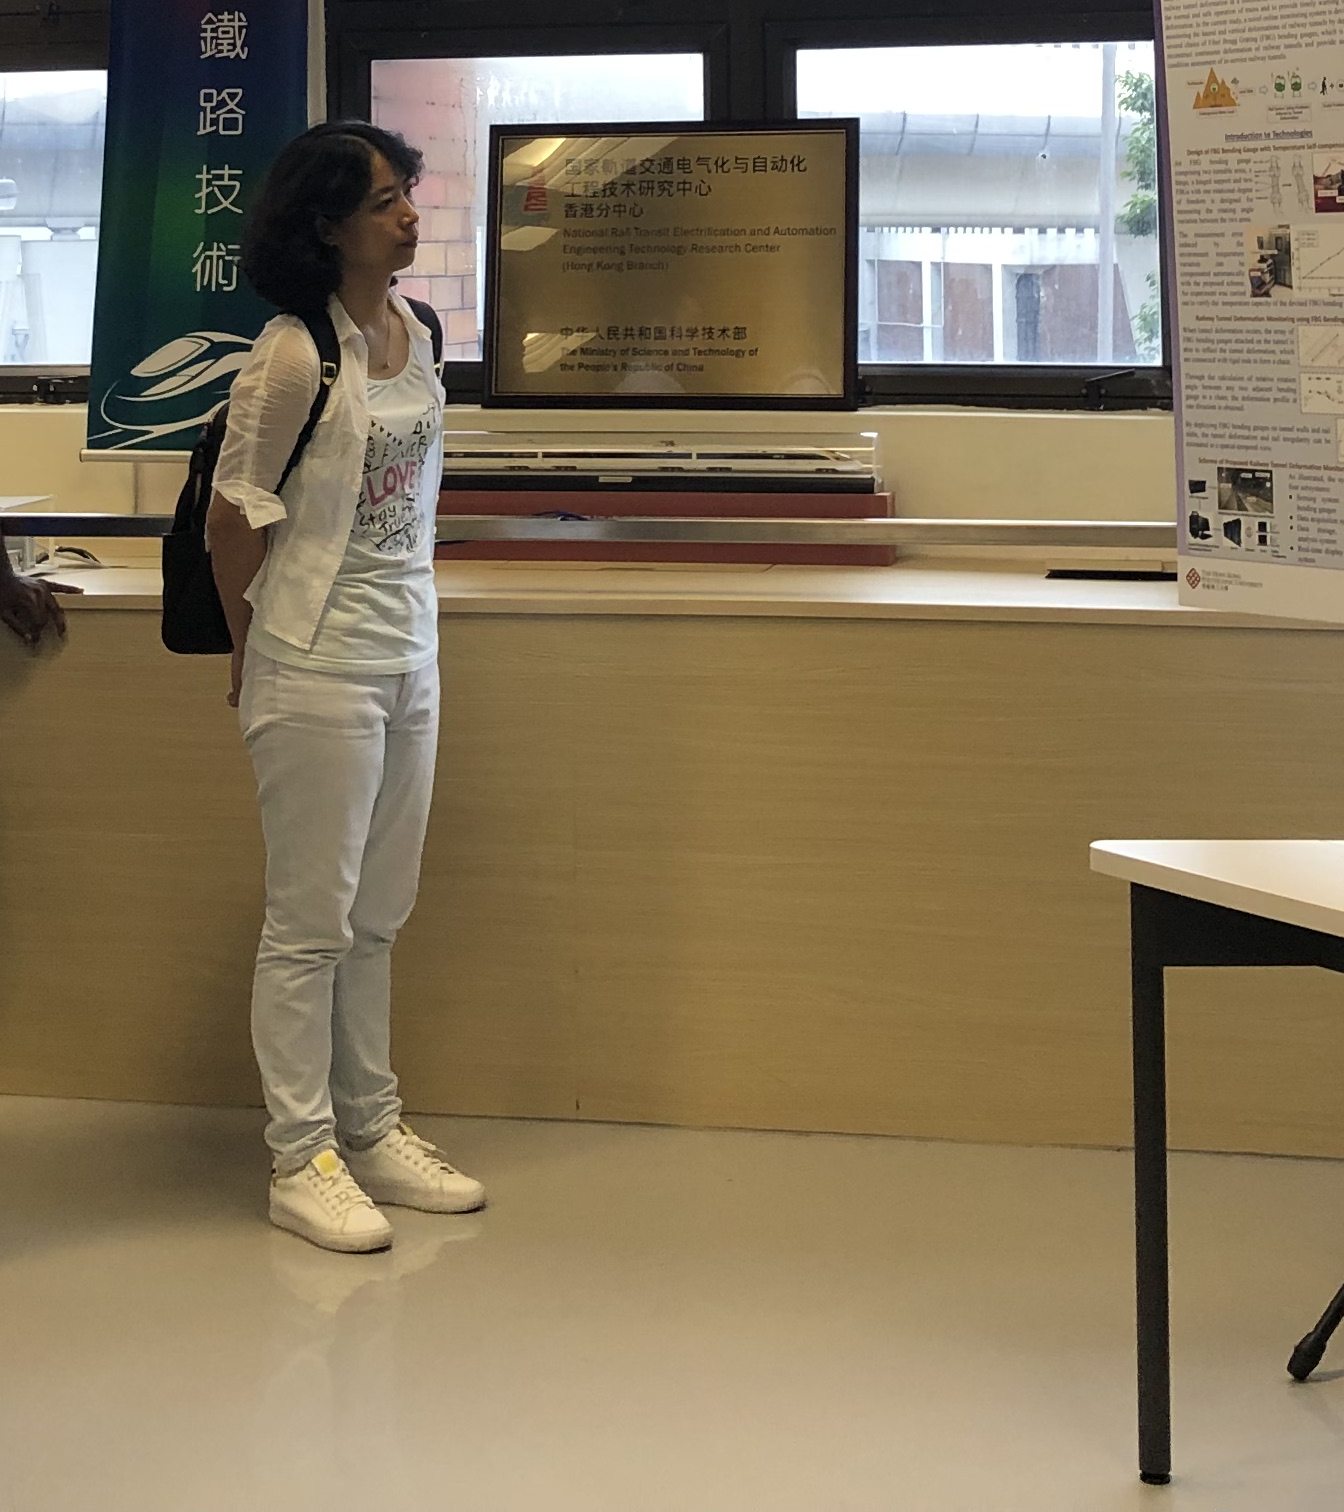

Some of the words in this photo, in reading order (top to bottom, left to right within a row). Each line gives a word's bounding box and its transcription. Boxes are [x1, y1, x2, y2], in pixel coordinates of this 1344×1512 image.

[1225, 131, 1262, 142] Introduction
[1264, 131, 1270, 139] to
[1273, 129, 1313, 139] Technologies
[1273, 144, 1305, 153] Temperature
[564, 203, 644, 218] 香港分中心
[563, 227, 608, 238] National
[634, 227, 669, 238] Transit
[673, 227, 747, 238] Electrification
[750, 226, 770, 237] and
[773, 225, 836, 236] Automation
[563, 243, 626, 257] Engineering
[628, 243, 688, 256] Technology
[691, 243, 741, 254] Research
[744, 242, 780, 254] Center
[562, 259, 594, 273] (Hong
[597, 260, 624, 272] Kong
[627, 259, 669, 272] Branch)
[560, 326, 748, 340] 中华人民共和国科学技术部
[580, 348, 616, 357] Ministry
[620, 348, 630, 356] of
[632, 348, 669, 356] Science
[671, 348, 689, 356] and
[692, 348, 746, 358] Technology
[749, 348, 759, 356] of
[560, 363, 574, 371] the
[621, 362, 663, 372] Republic
[664, 362, 674, 372] of
[676, 362, 704, 372] China
[1289, 462, 1322, 470] Deformation
[367, 461, 417, 507] LOVE
[360, 505, 396, 529] Stay
